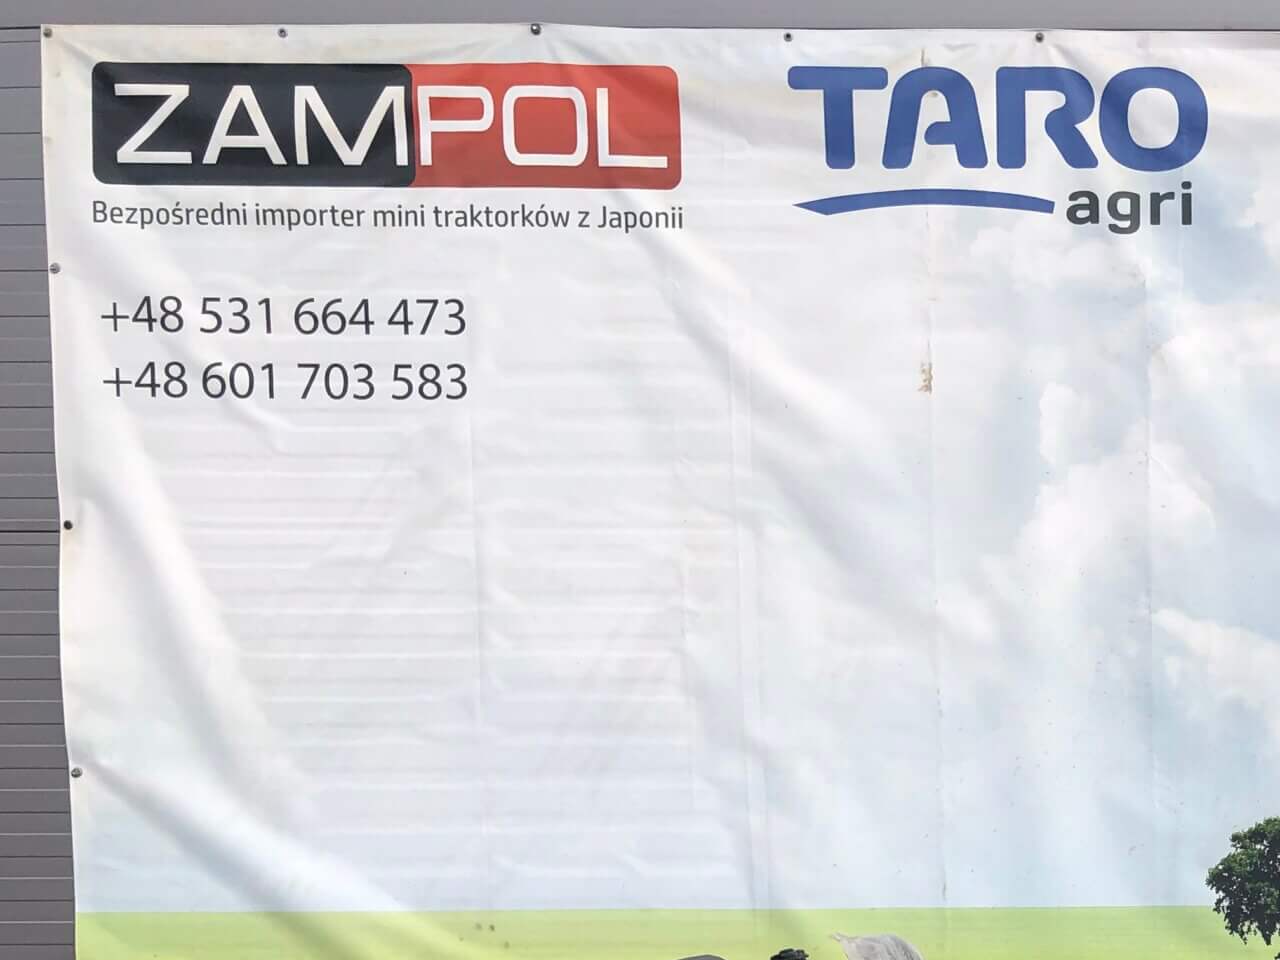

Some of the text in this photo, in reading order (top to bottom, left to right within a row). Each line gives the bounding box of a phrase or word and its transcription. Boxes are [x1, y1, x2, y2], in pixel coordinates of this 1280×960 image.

[114, 83, 669, 168] ZAMPOL
[788, 66, 1208, 172] TARO
[92, 200, 684, 233] Bezpośredni importer mini traktorków z Japonii
[1066, 181, 1193, 235] agri
[101, 296, 467, 336] +48 531 664 473
[103, 361, 468, 400] +48 601 703 583
